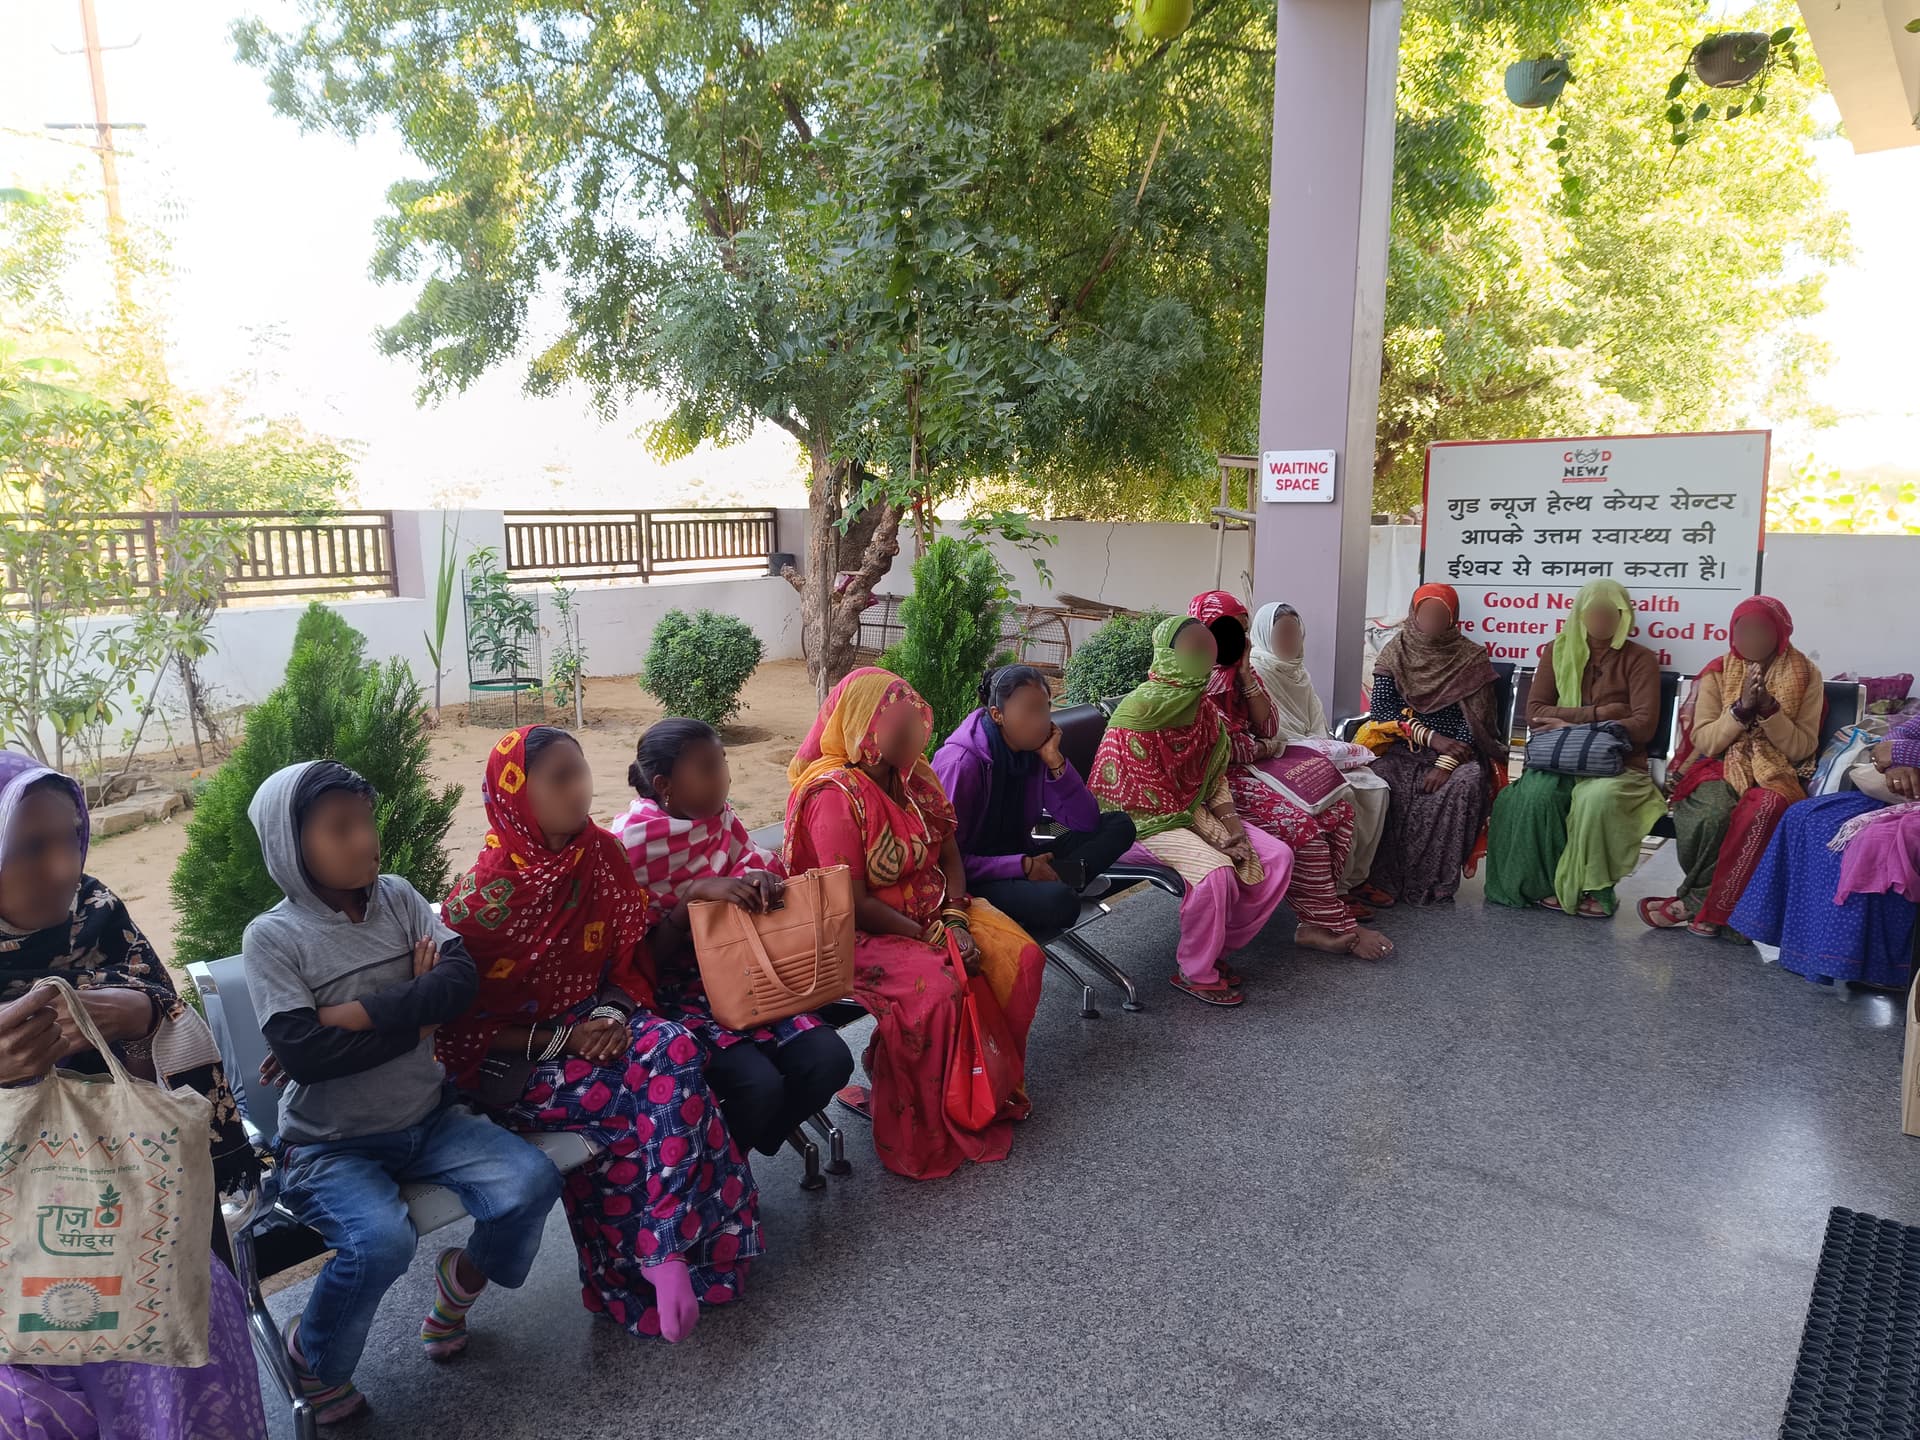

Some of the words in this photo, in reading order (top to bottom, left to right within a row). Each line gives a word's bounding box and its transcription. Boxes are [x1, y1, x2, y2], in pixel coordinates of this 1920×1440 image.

[1269, 462, 1328, 475] WAITING
[1564, 465, 1609, 477] NEWS
[1276, 478, 1320, 491] SPACE
[1448, 498, 1481, 521] गुड
[1489, 497, 1537, 520] न्यूज
[1546, 490, 1593, 515] हेल्थ
[1603, 488, 1660, 511] केयर
[1670, 487, 1737, 510] सेन्टर
[1461, 523, 1524, 544] आपके
[1533, 529, 1582, 544] उत्तम
[1592, 528, 1672, 544] स्वास्थ्य
[1682, 520, 1716, 544] की
[1448, 554, 1503, 579] ईश्वर
[1512, 554, 1532, 576] से
[1541, 561, 1614, 577] कामना
[1624, 562, 1688, 578] करता
[1483, 592, 1539, 609] Good
[1546, 593, 1575, 610] Ne
[1629, 595, 1680, 612] ealth
[1456, 619, 1475, 632] re
[1481, 616, 1548, 635] Center
[1647, 621, 1696, 640] God
[1703, 623, 1728, 641] Fo
[1484, 641, 1530, 659] Your
[36, 1205, 93, 1232] राज
[58, 1229, 116, 1251] सीड्स
